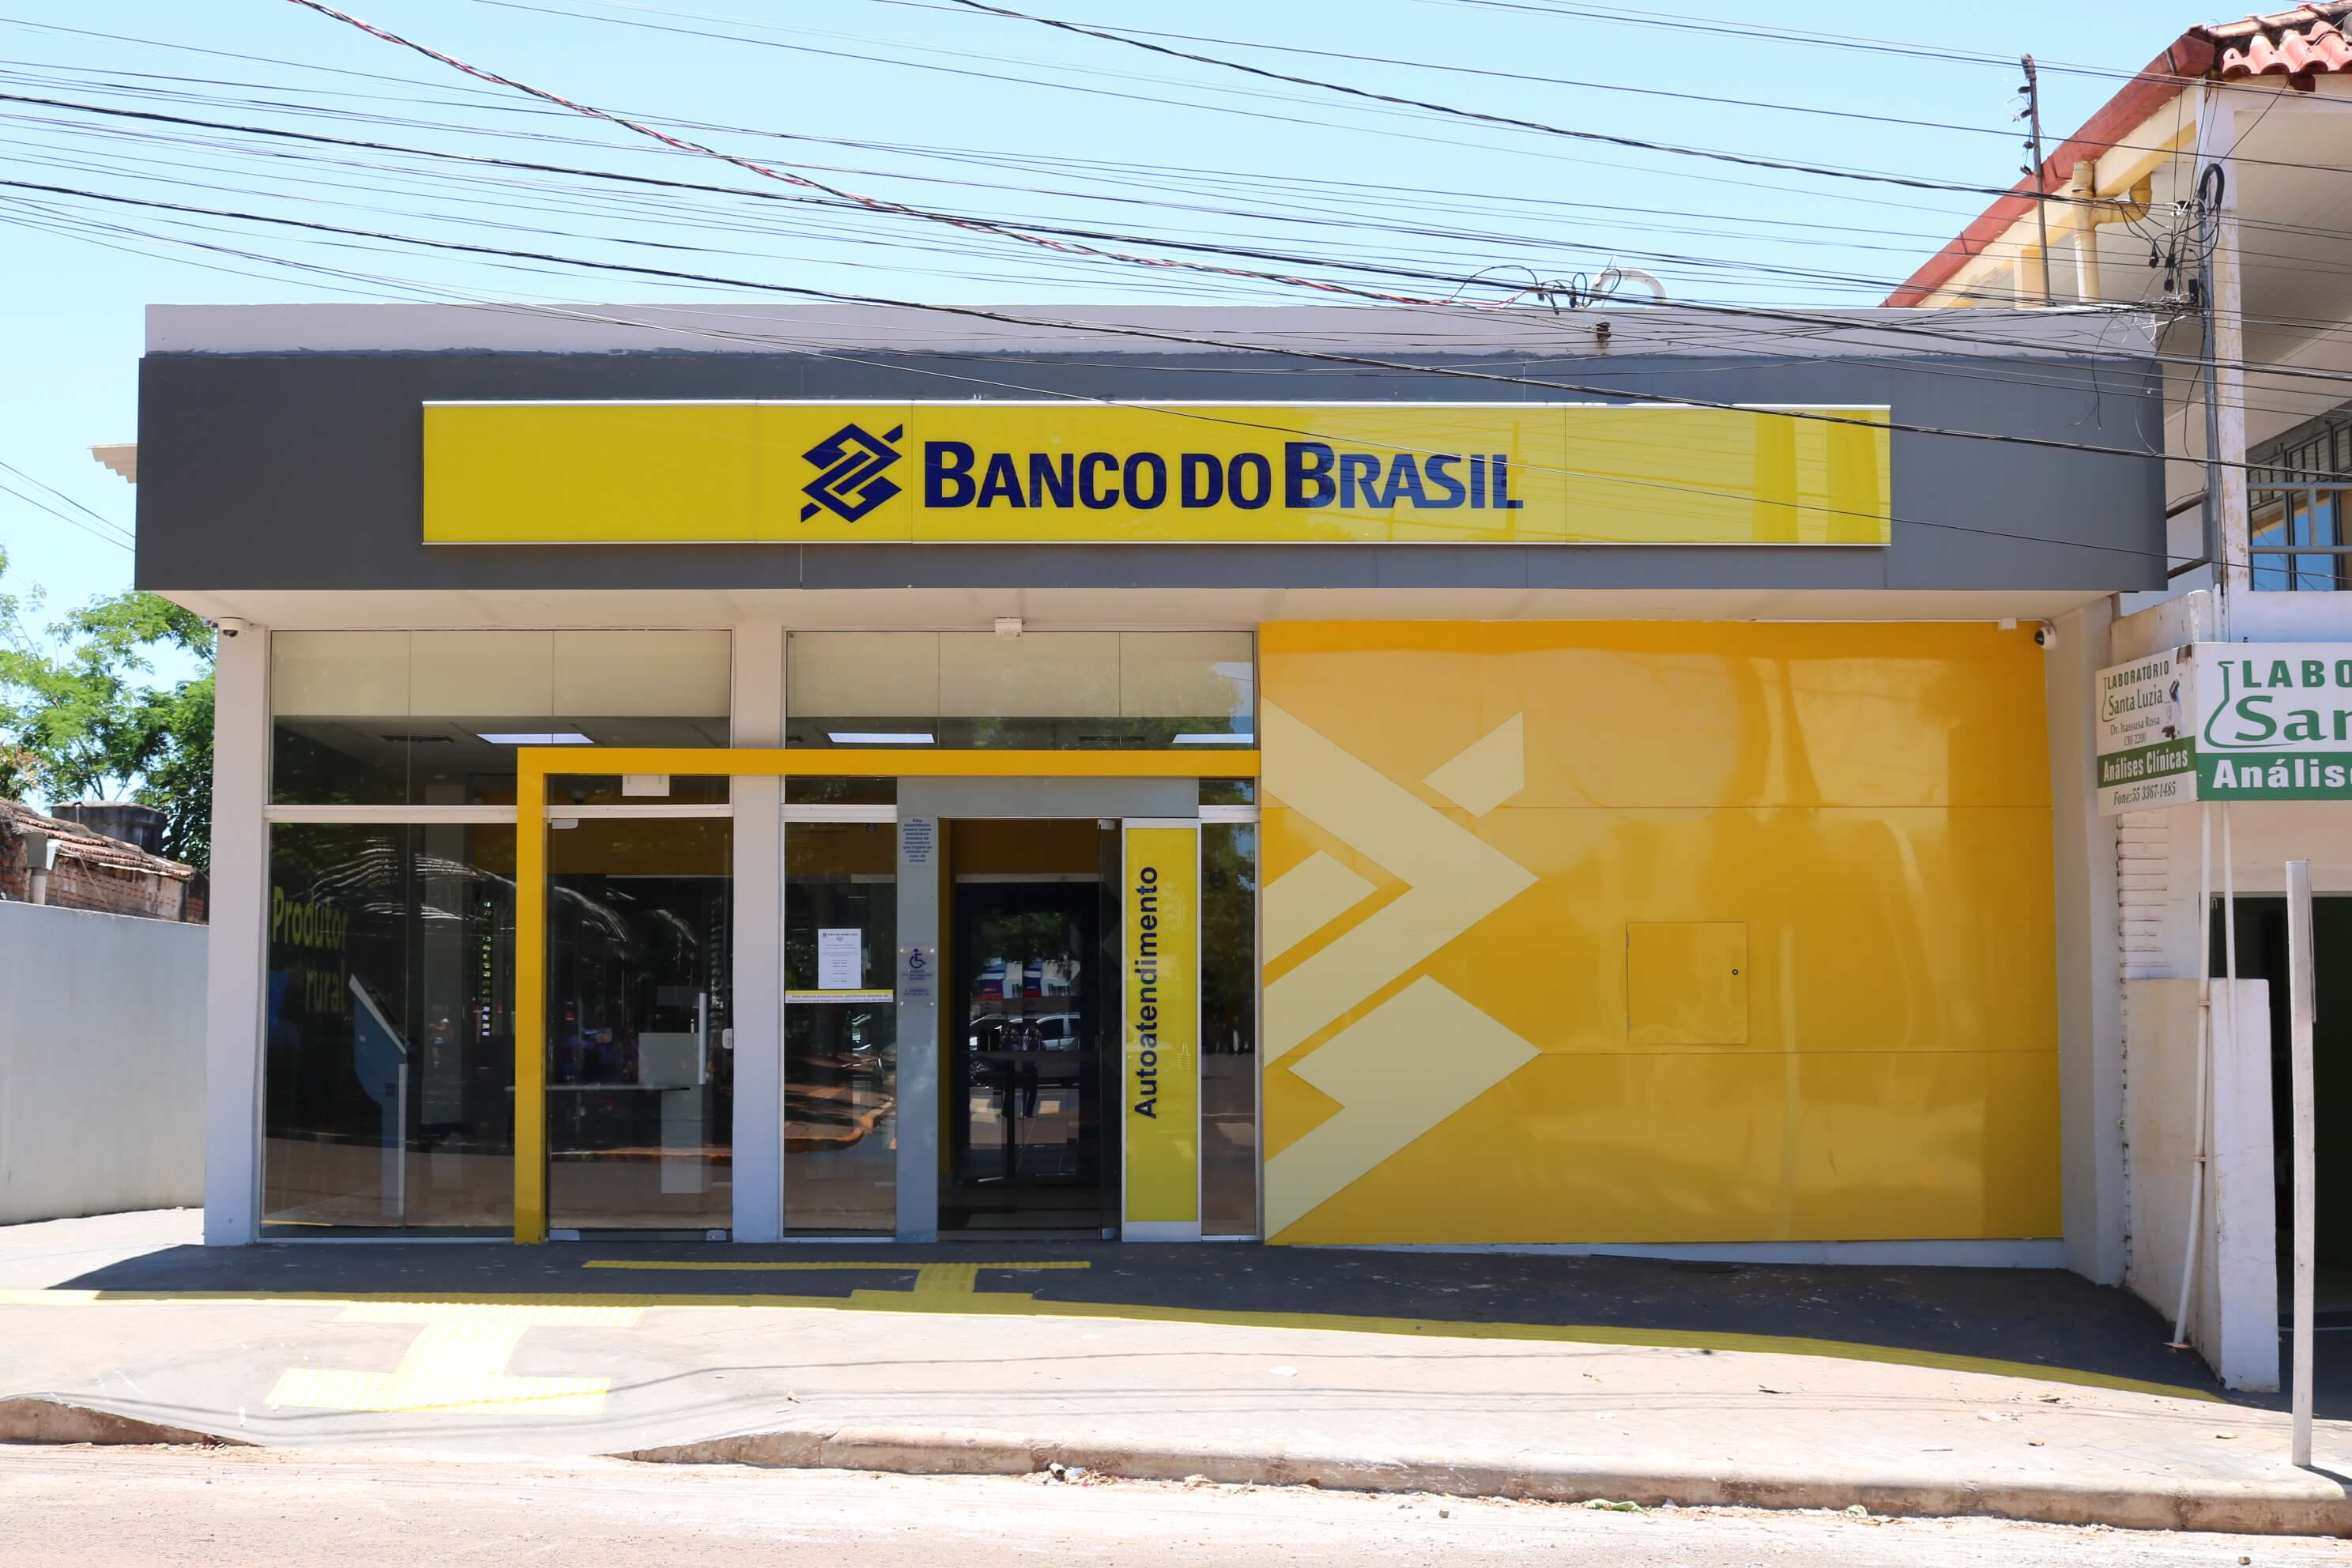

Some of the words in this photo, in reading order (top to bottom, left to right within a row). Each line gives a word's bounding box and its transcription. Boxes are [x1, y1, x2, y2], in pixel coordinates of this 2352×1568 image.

[925, 441, 1167, 510] BANCO
[1181, 452, 1271, 510] DO
[1285, 442, 1524, 510] BRASIL
[2108, 660, 2169, 691] LABORATÓRIO
[2109, 695, 2135, 716] Santa
[2137, 684, 2163, 709] Luzia
[2145, 716, 2160, 728] Rosa
[2103, 755, 2144, 782] Análises
[2146, 748, 2188, 775] Clínicas
[2213, 758, 2352, 789] Anális
[272, 885, 349, 949] Produtor
[1134, 867, 1157, 1119] Autoatendimento
